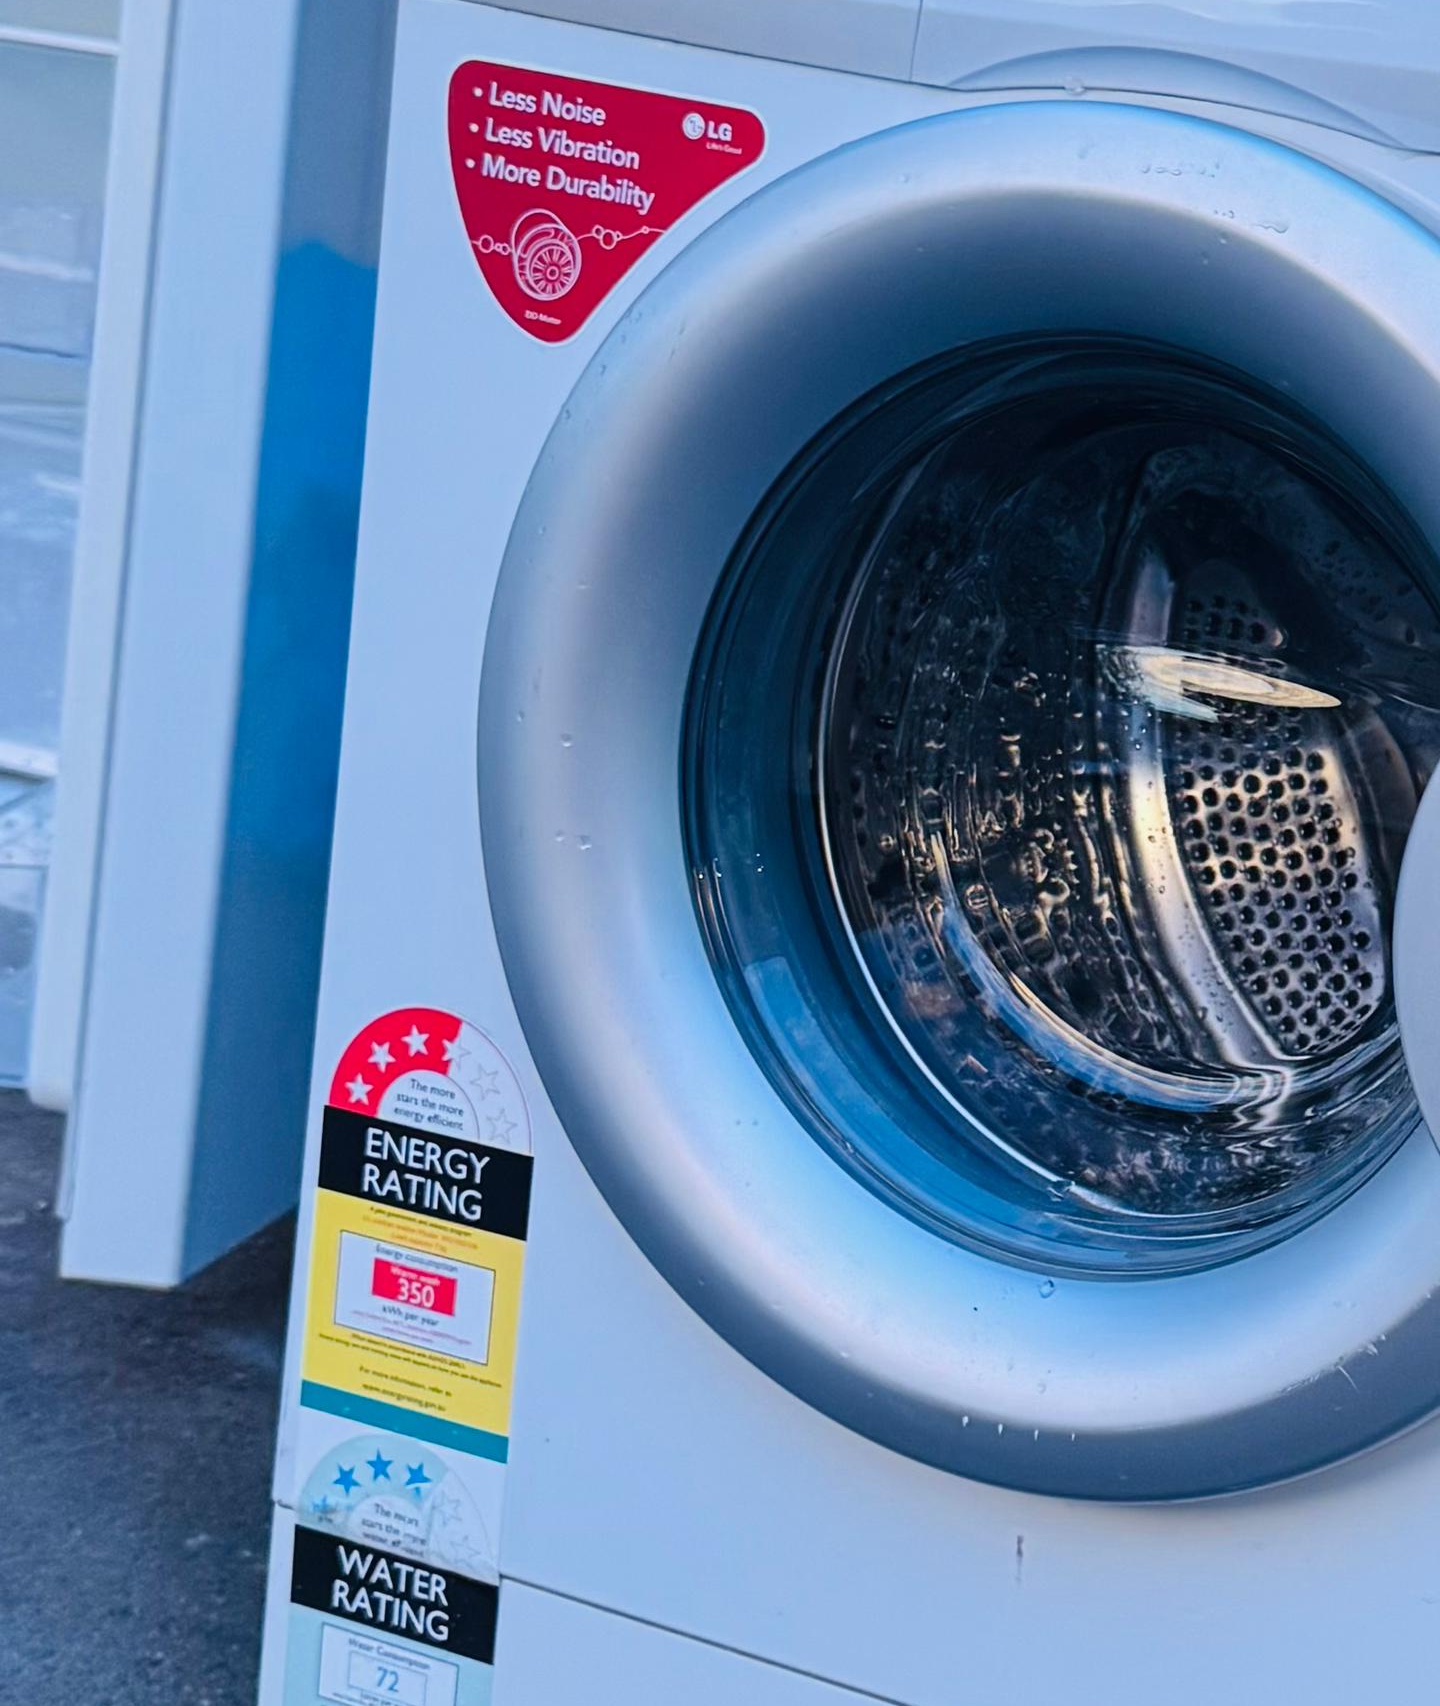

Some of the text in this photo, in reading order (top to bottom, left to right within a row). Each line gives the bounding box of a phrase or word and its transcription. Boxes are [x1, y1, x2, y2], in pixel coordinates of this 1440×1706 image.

[488, 81, 607, 127] Less Noise
[484, 117, 641, 170] Less Vibration
[707, 120, 733, 142] LG
[481, 152, 656, 216] More Durability
[396, 1093, 464, 1117] stars the more
[410, 1078, 456, 1100] The more
[394, 1107, 464, 1131] energy efficient
[364, 1126, 491, 1185] ENERGY
[362, 1163, 483, 1221] RATING
[397, 1277, 435, 1308] 350
[374, 1502, 392, 1518] The
[336, 1544, 449, 1607] WATER
[331, 1579, 450, 1643] RATING
[376, 1665, 400, 1694] 72
